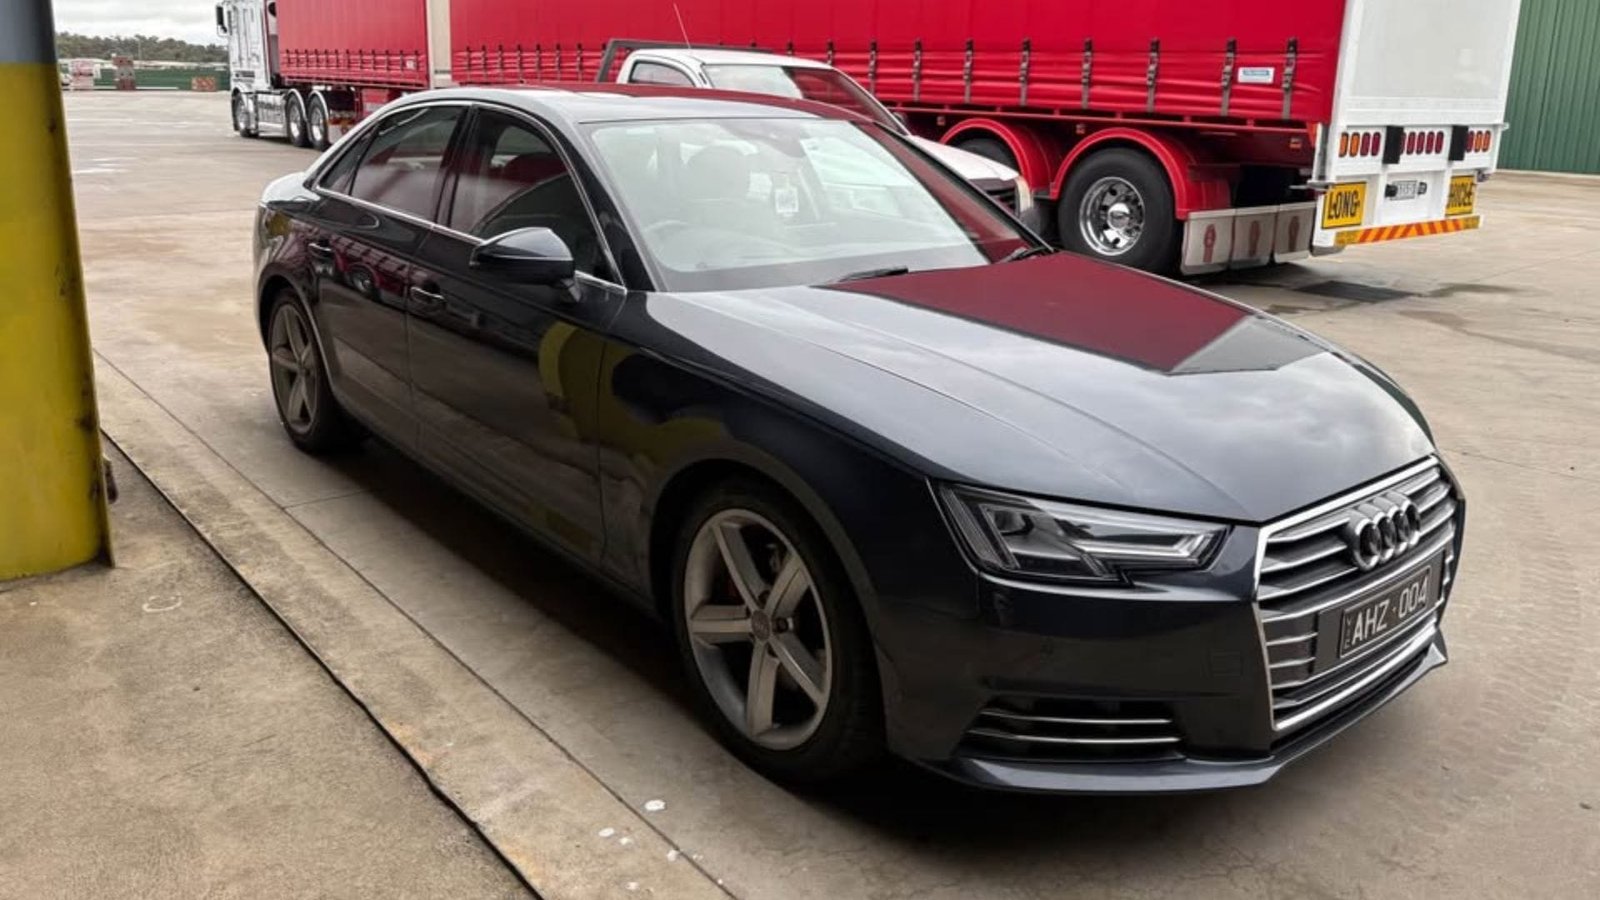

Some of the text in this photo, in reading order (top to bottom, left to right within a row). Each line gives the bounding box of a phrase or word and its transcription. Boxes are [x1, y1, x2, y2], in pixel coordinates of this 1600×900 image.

[1327, 190, 1360, 220] LONG
[1446, 182, 1474, 209] HICLE
[1351, 576, 1428, 646] AHZ 004
